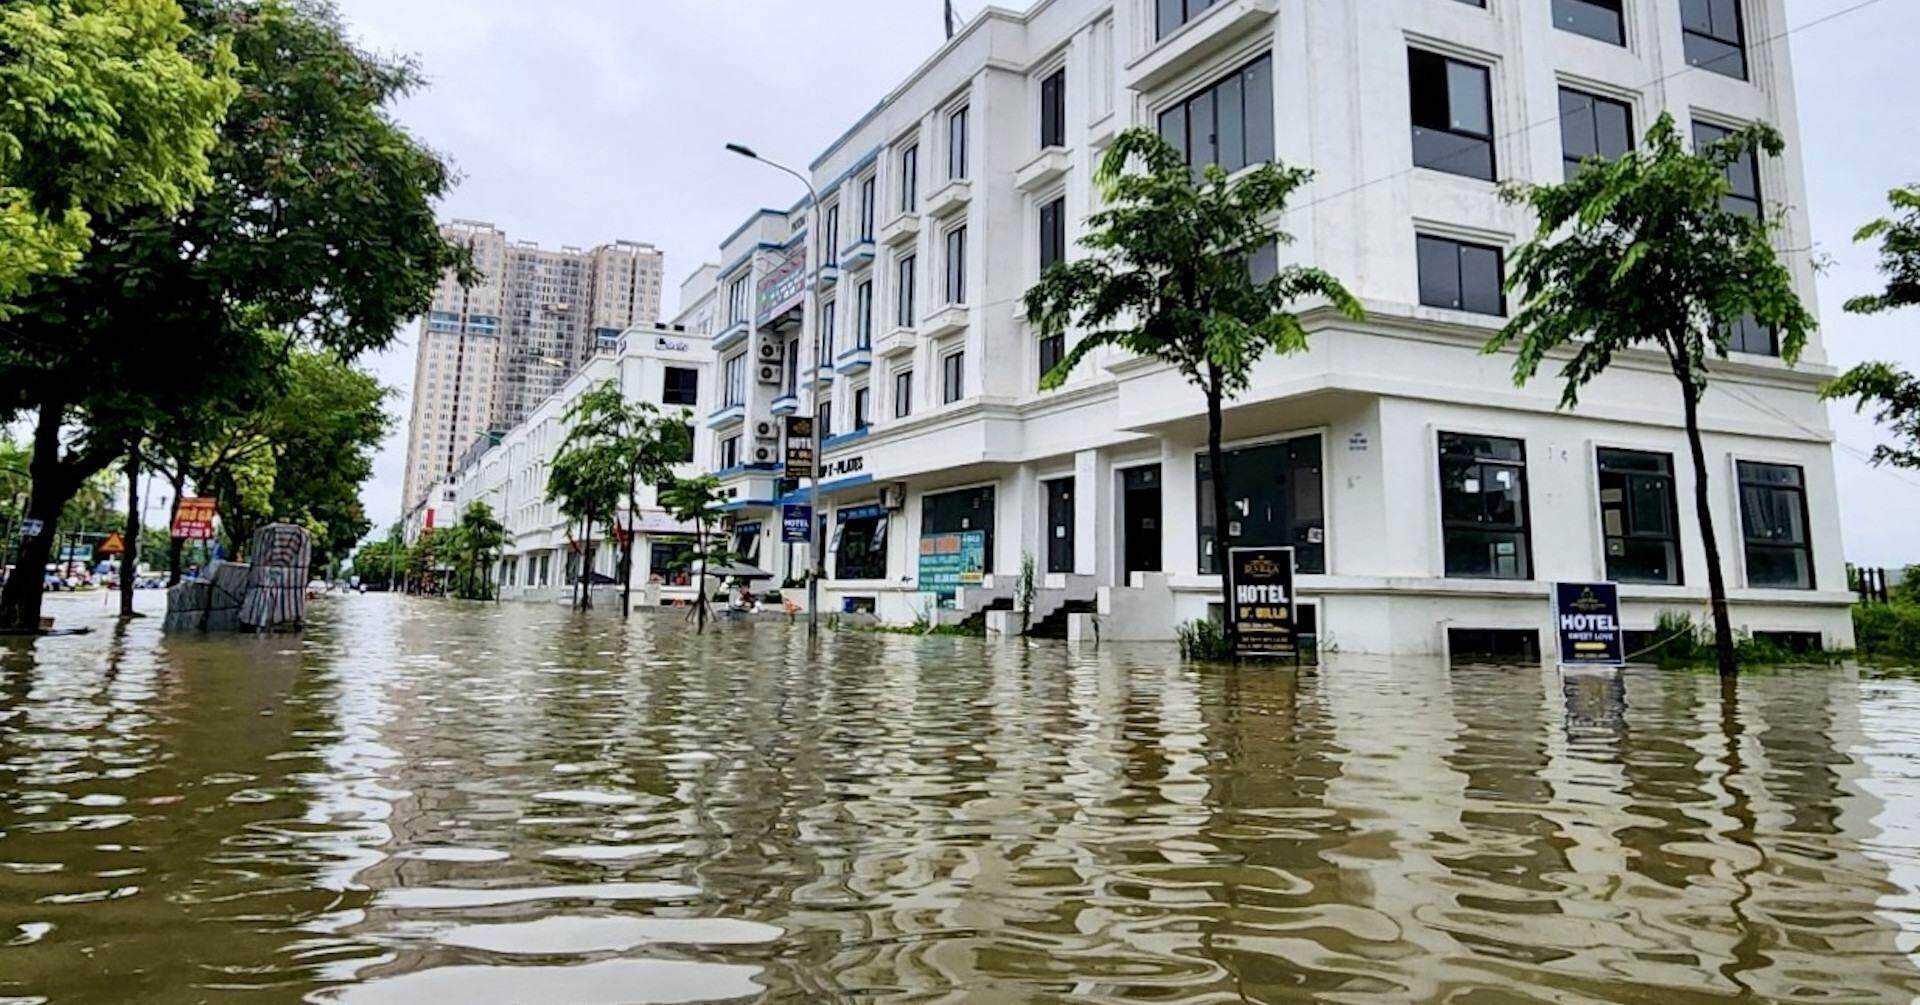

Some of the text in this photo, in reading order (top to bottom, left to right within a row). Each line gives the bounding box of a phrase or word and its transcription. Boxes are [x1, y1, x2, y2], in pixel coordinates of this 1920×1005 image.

[1236, 584, 1290, 604] HOTEL
[1560, 613, 1619, 631] HOTEL
[1594, 633, 1614, 641] LOVE
